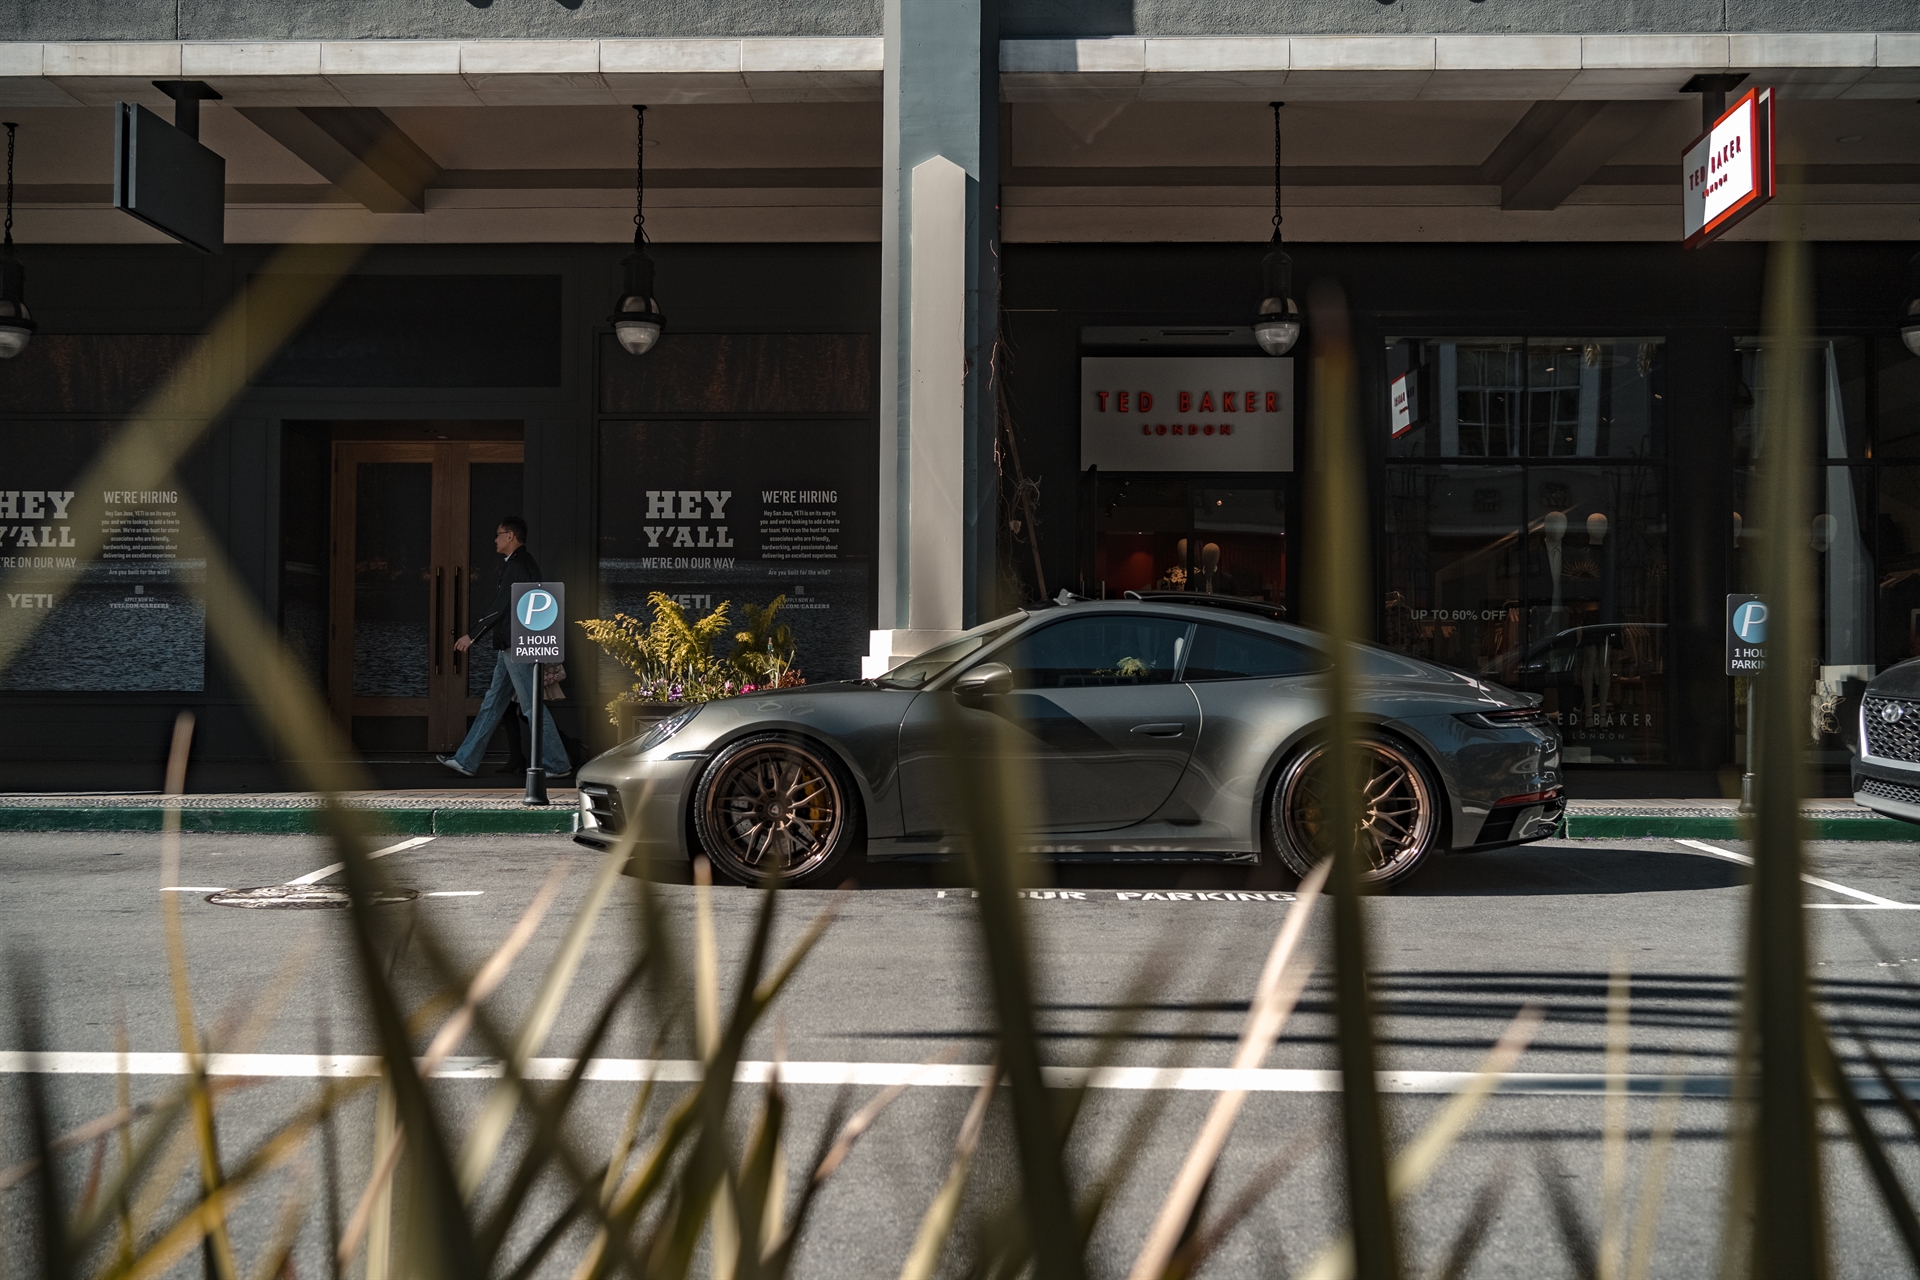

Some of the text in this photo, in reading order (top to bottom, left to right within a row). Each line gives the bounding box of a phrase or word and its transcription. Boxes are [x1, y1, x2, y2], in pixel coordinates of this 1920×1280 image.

[1689, 136, 1741, 191] TED BAKER
[1702, 173, 1728, 199] LONDON
[1097, 391, 1277, 412] TED BAKER
[1144, 424, 1231, 436] LONDON
[103, 491, 178, 504] WE'RE HIRING
[762, 490, 838, 503] WE'RE HIRING
[0, 491, 75, 519] HEY
[646, 491, 732, 519] HEY
[643, 526, 734, 547] Y'ALL
[0, 557, 77, 568] 'RE ON OUR WAY
[642, 557, 735, 569] WE'RE ON OUR WAY
[7, 593, 53, 609] YETI
[524, 592, 552, 625] P
[1410, 609, 1507, 620] UP TO 60% OFF
[1741, 604, 1769, 637] P
[518, 635, 557, 645] 1 HOUR
[516, 647, 559, 656] PARKING
[1734, 648, 1767, 658] 1 HOU
[1731, 659, 1767, 669] PARKIN
[1593, 713, 1652, 726] BAKER
[1116, 892, 1297, 902] PARKING
